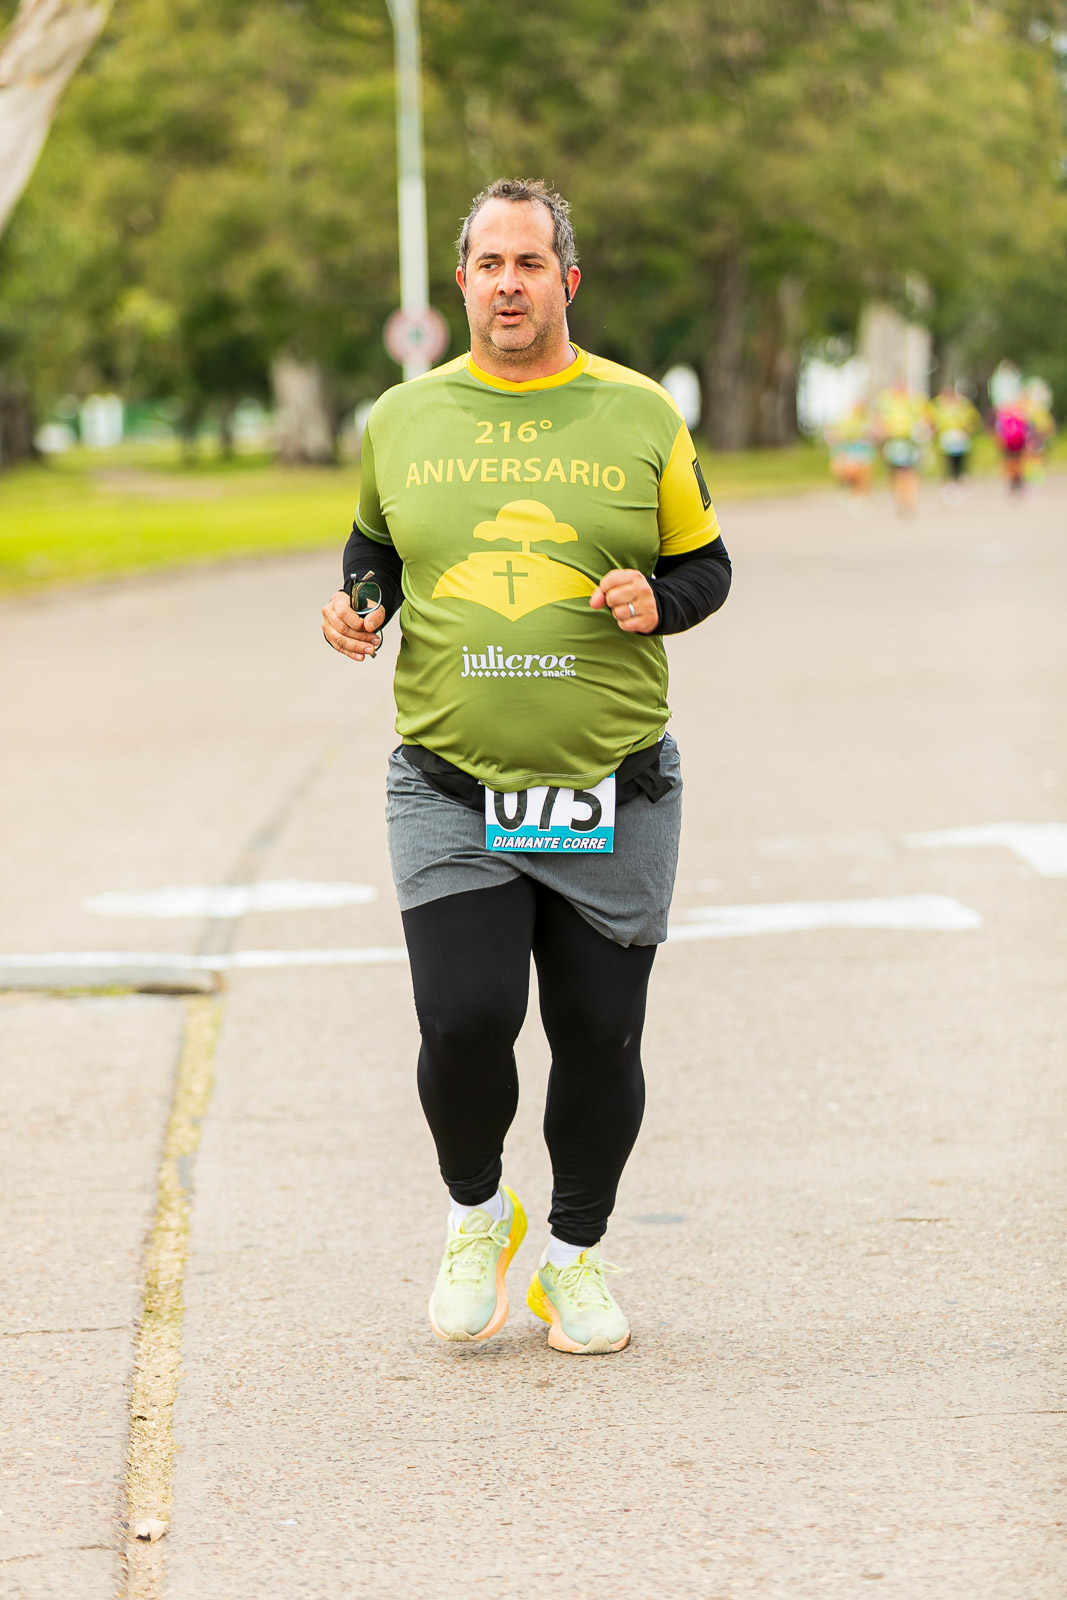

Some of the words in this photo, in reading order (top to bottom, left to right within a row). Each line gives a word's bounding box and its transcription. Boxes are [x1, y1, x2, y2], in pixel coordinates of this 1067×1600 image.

[474, 419, 553, 444] 216°
[405, 457, 626, 492] ANIVERSARIO
[460, 645, 577, 678] julicroc
[542, 669, 577, 678] snacks
[492, 836, 561, 849] DIAMANTE
[562, 837, 607, 849] CORRE
